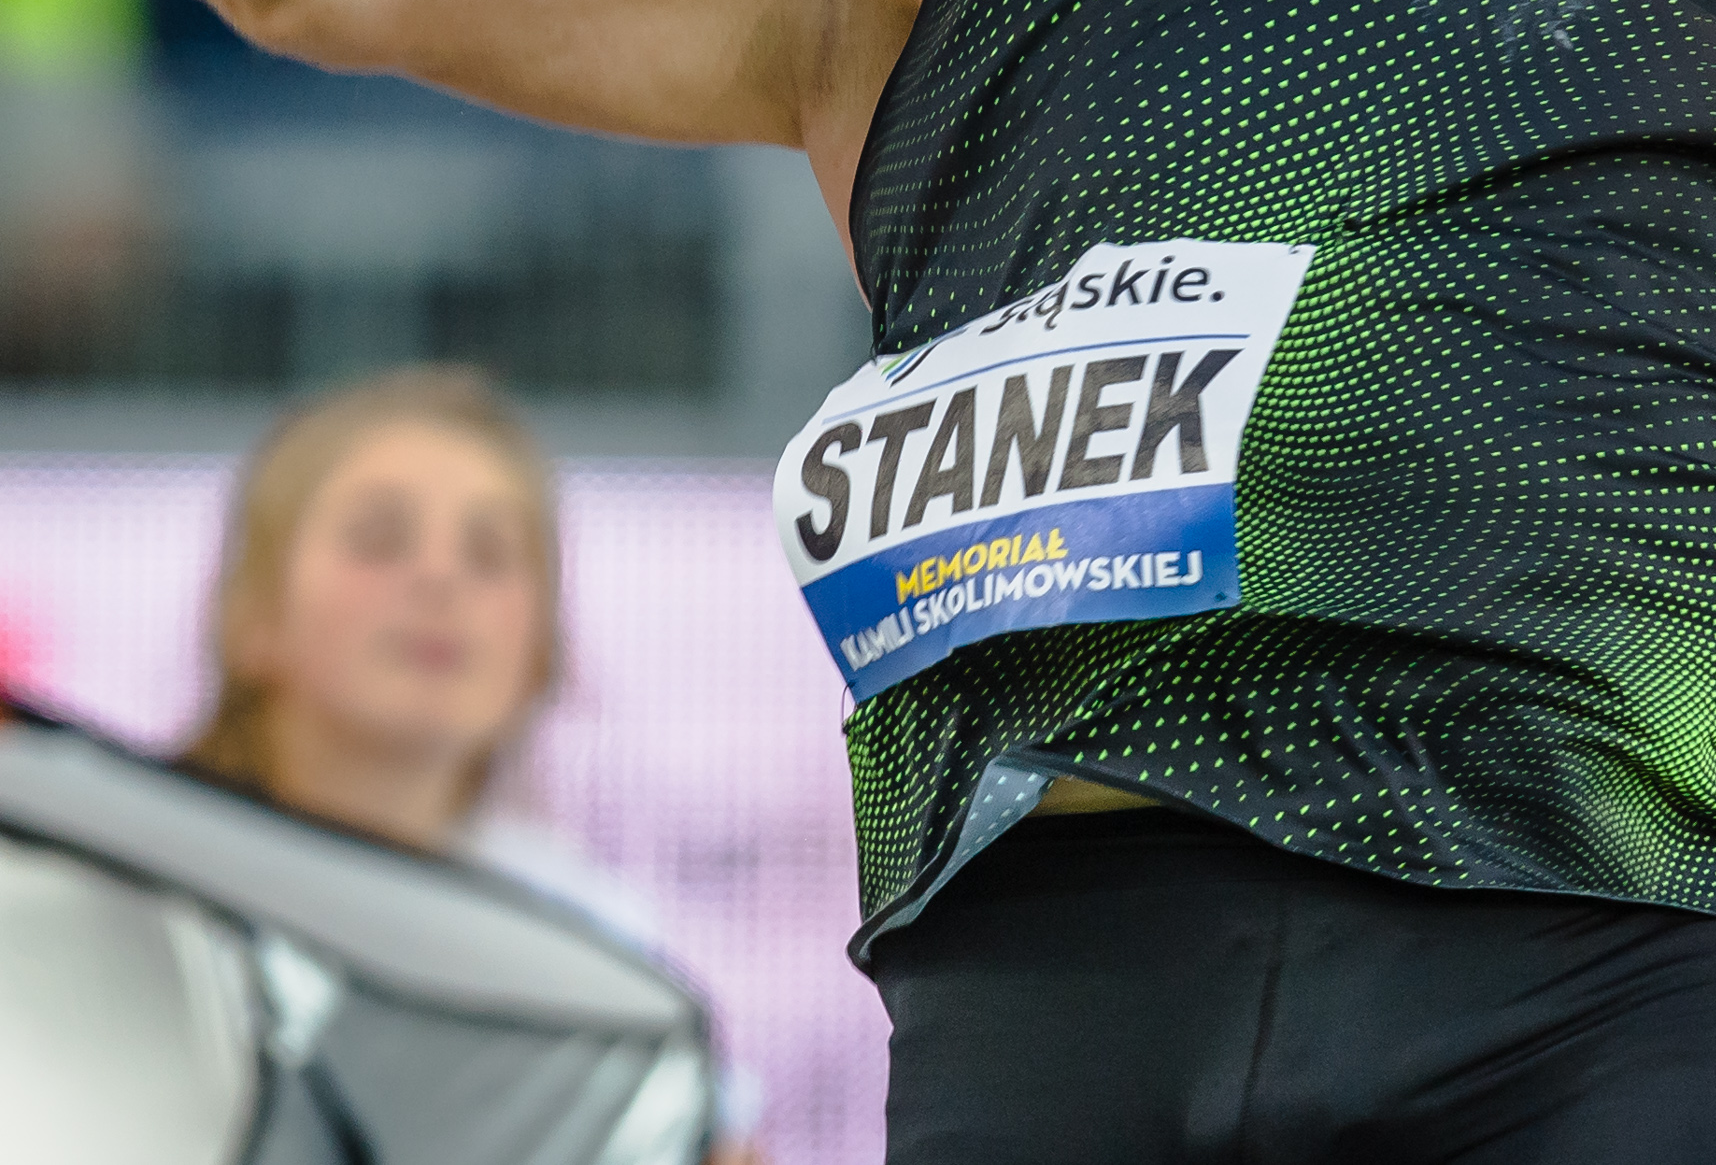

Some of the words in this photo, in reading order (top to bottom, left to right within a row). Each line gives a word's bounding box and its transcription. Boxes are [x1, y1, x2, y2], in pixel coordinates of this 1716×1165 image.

[796, 348, 1246, 561] STANEK
[895, 528, 1069, 605] MEMORIAŁ
[912, 550, 1204, 635] SKOLIMOWSKIEJ
